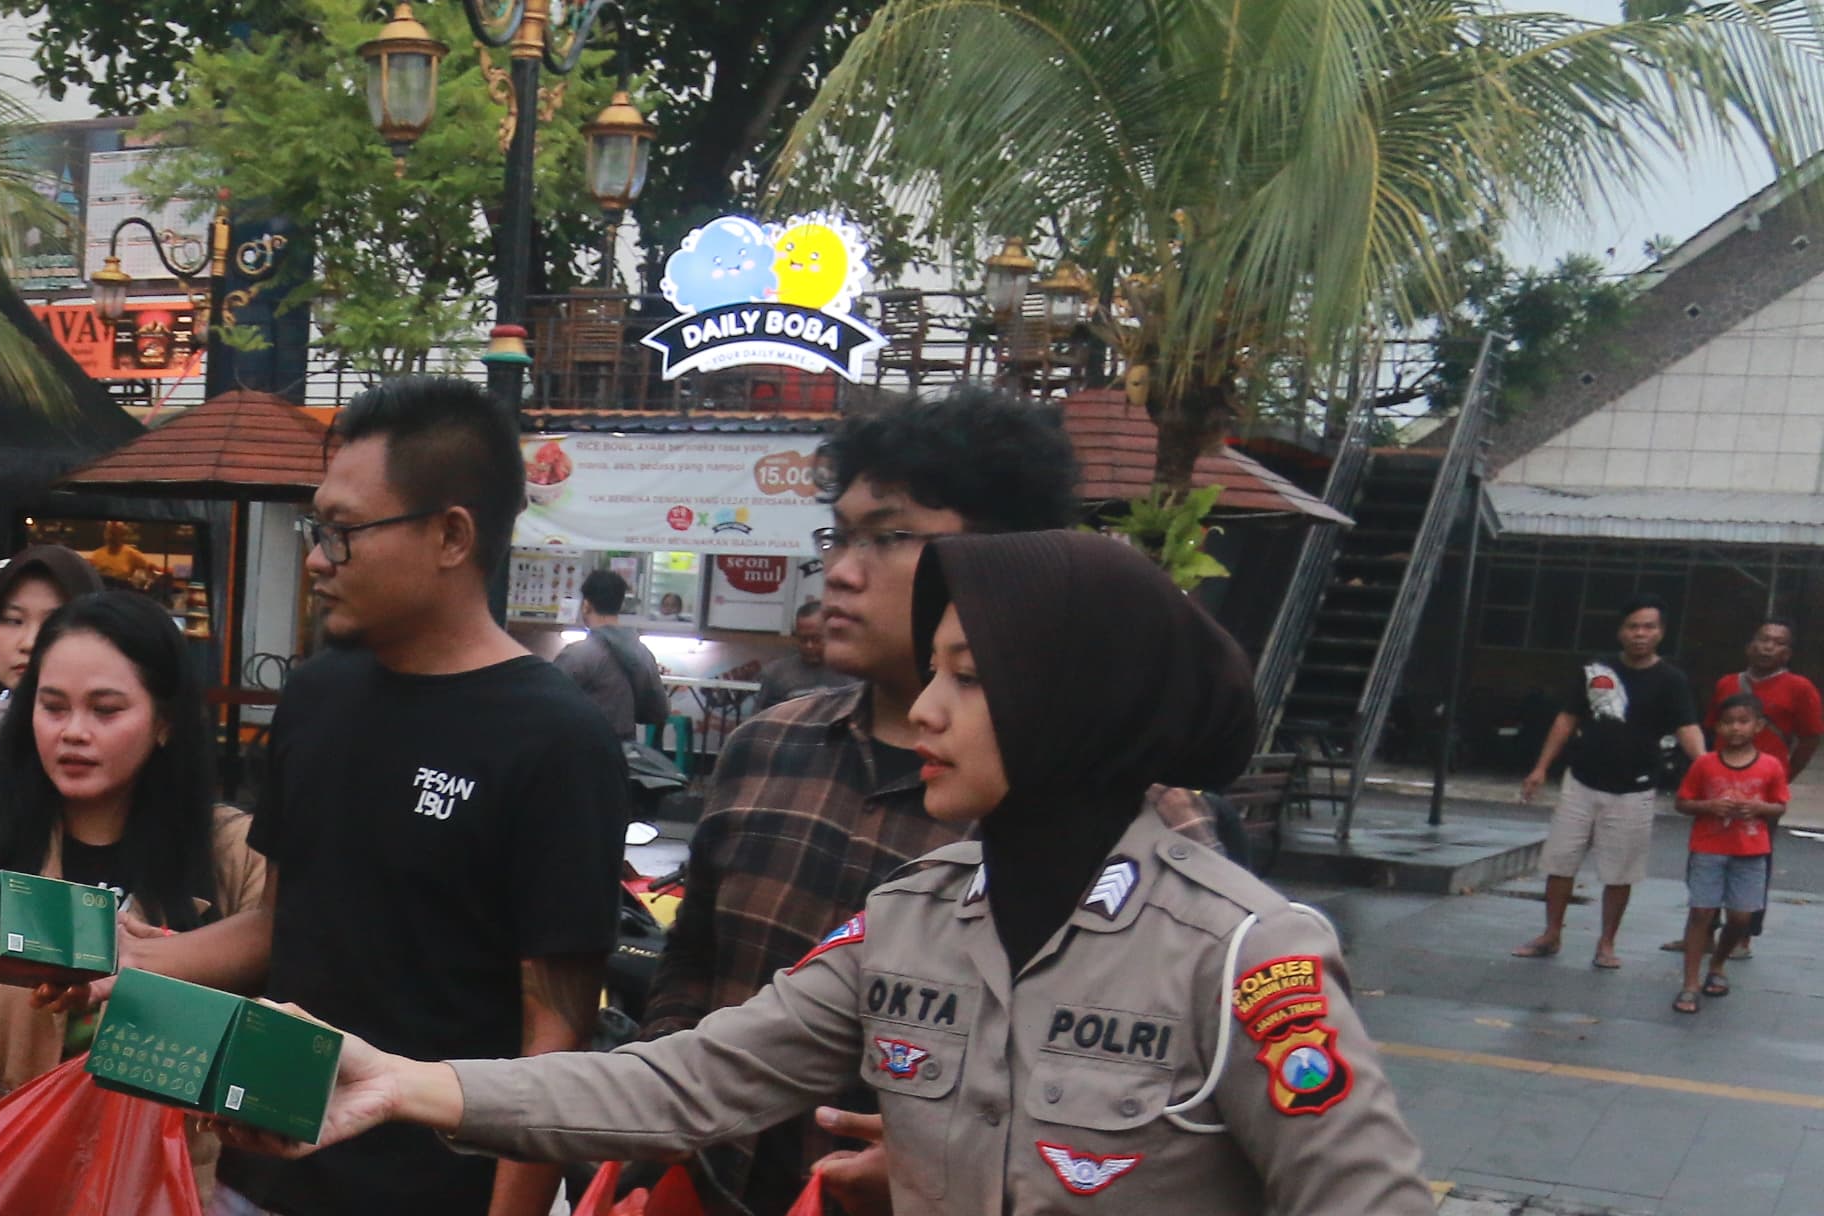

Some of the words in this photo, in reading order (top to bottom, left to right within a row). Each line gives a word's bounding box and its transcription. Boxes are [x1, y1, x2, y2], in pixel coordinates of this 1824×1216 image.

[681, 310, 761, 349] DAILY
[764, 310, 840, 351] BOBA
[712, 350, 740, 365] YOUR
[743, 349, 774, 358] DAILY
[727, 557, 770, 569] seon
[413, 767, 476, 801] PESAN
[413, 790, 456, 820] IBU
[1279, 975, 1314, 992] KOTA
[868, 978, 958, 1026] OKTA
[1047, 1008, 1172, 1060] POLRI
